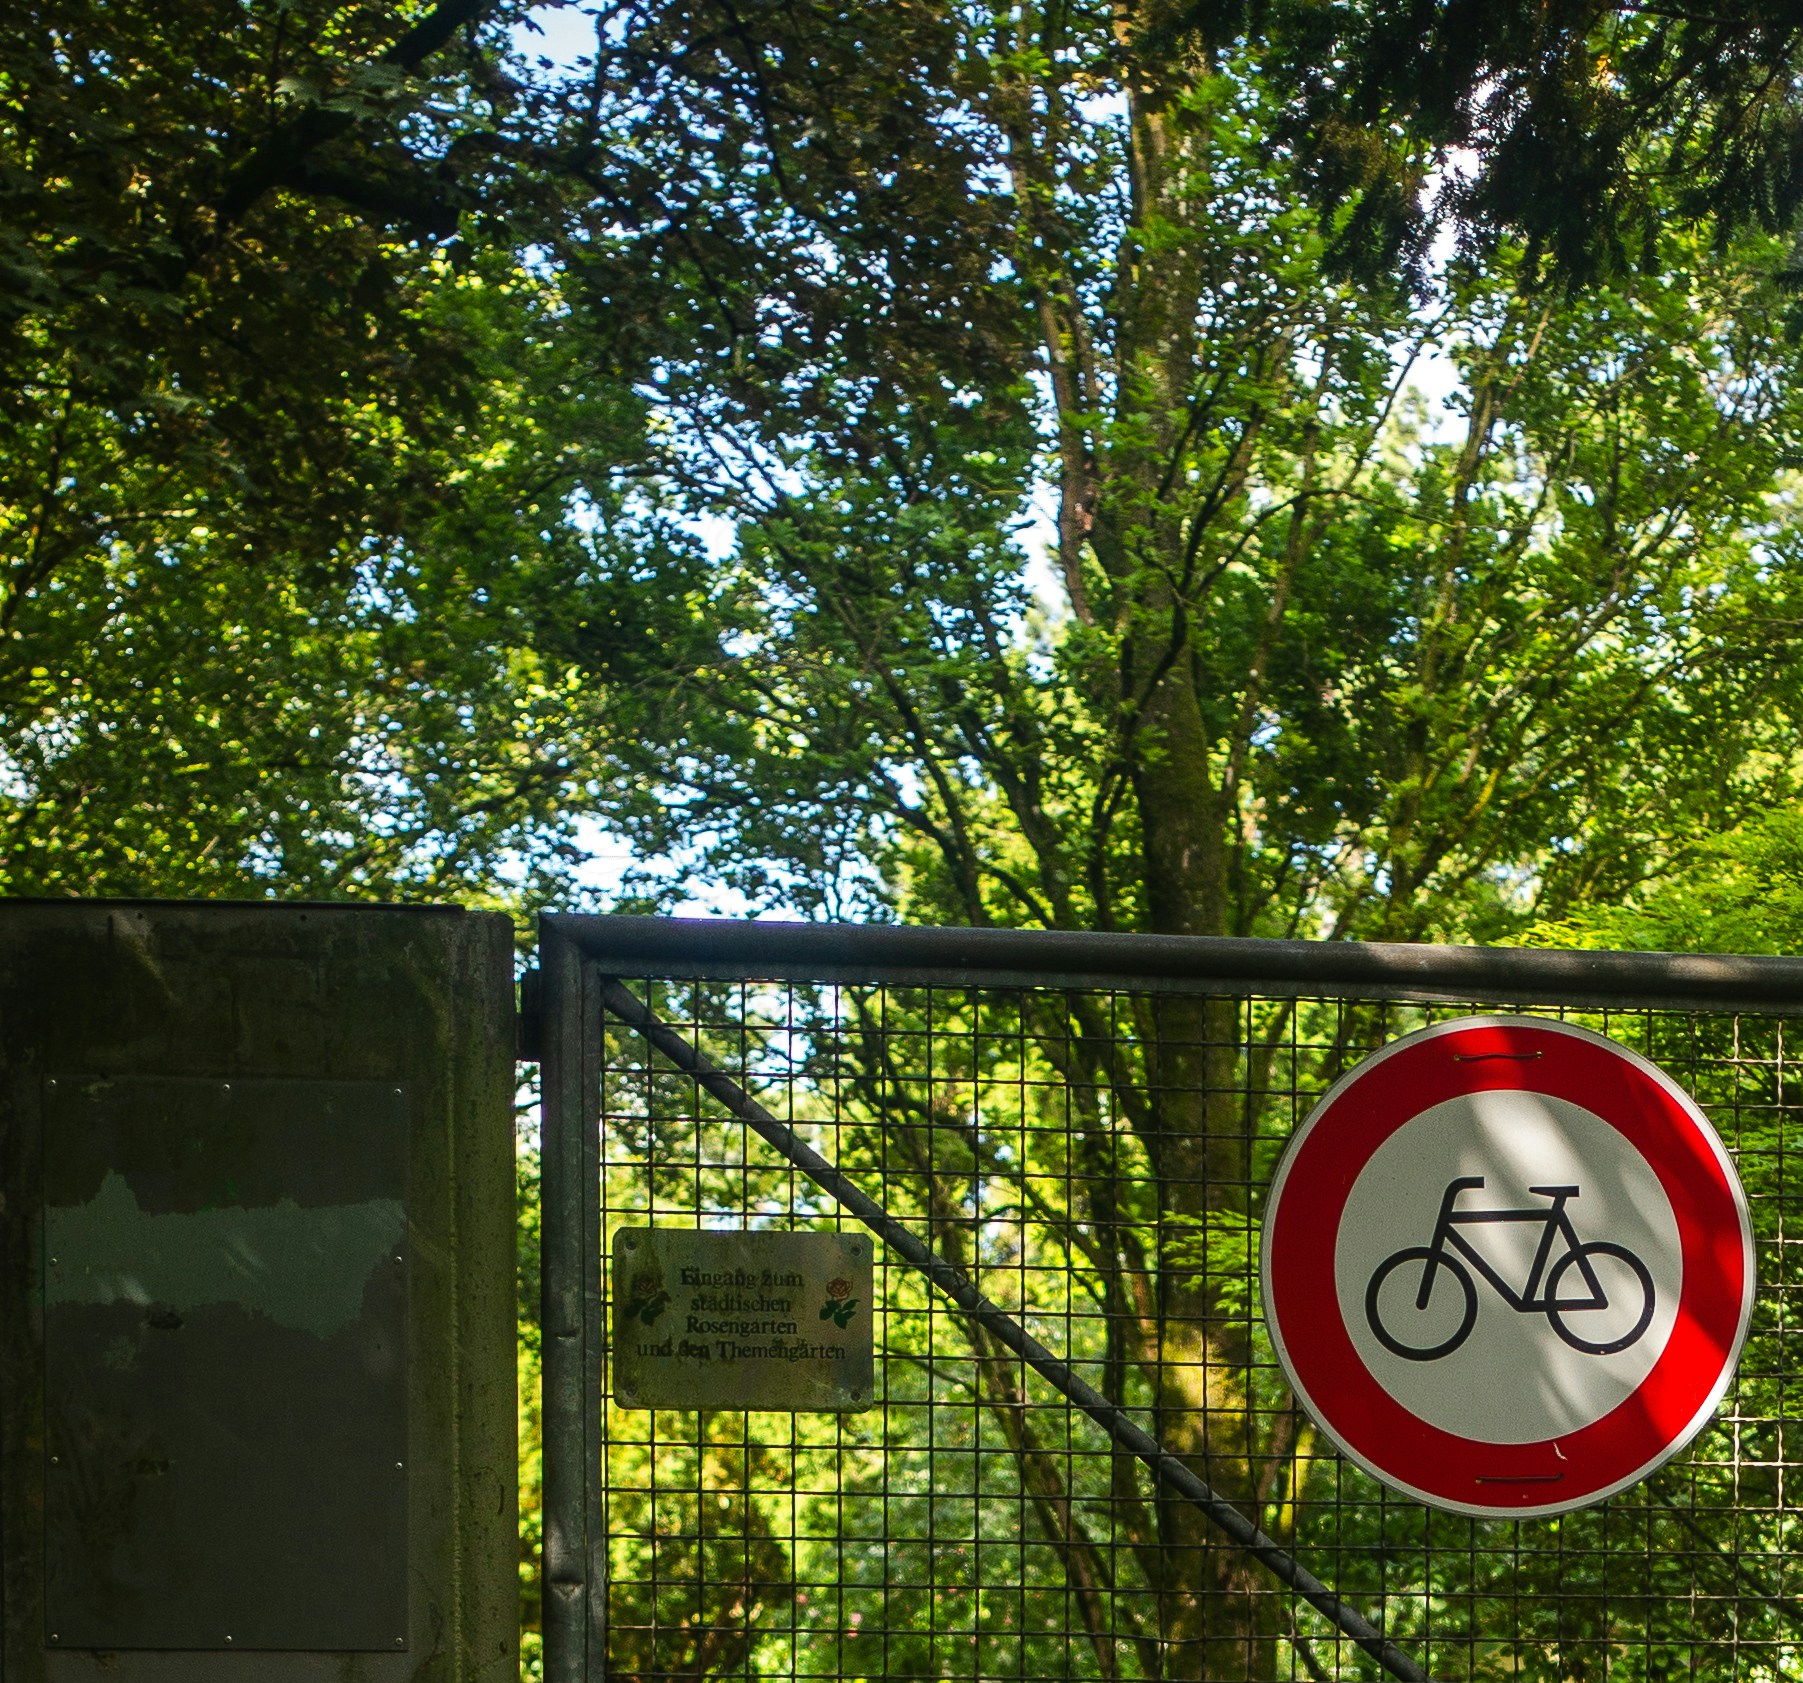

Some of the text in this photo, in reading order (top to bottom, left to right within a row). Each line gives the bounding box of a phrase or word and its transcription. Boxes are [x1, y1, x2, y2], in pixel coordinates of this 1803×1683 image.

[680, 1267, 803, 1289] Eingang zum
[691, 1295, 791, 1312] städtischen
[686, 1317, 797, 1337] Rosengarten
[637, 1337, 846, 1361] und den Themengärten
